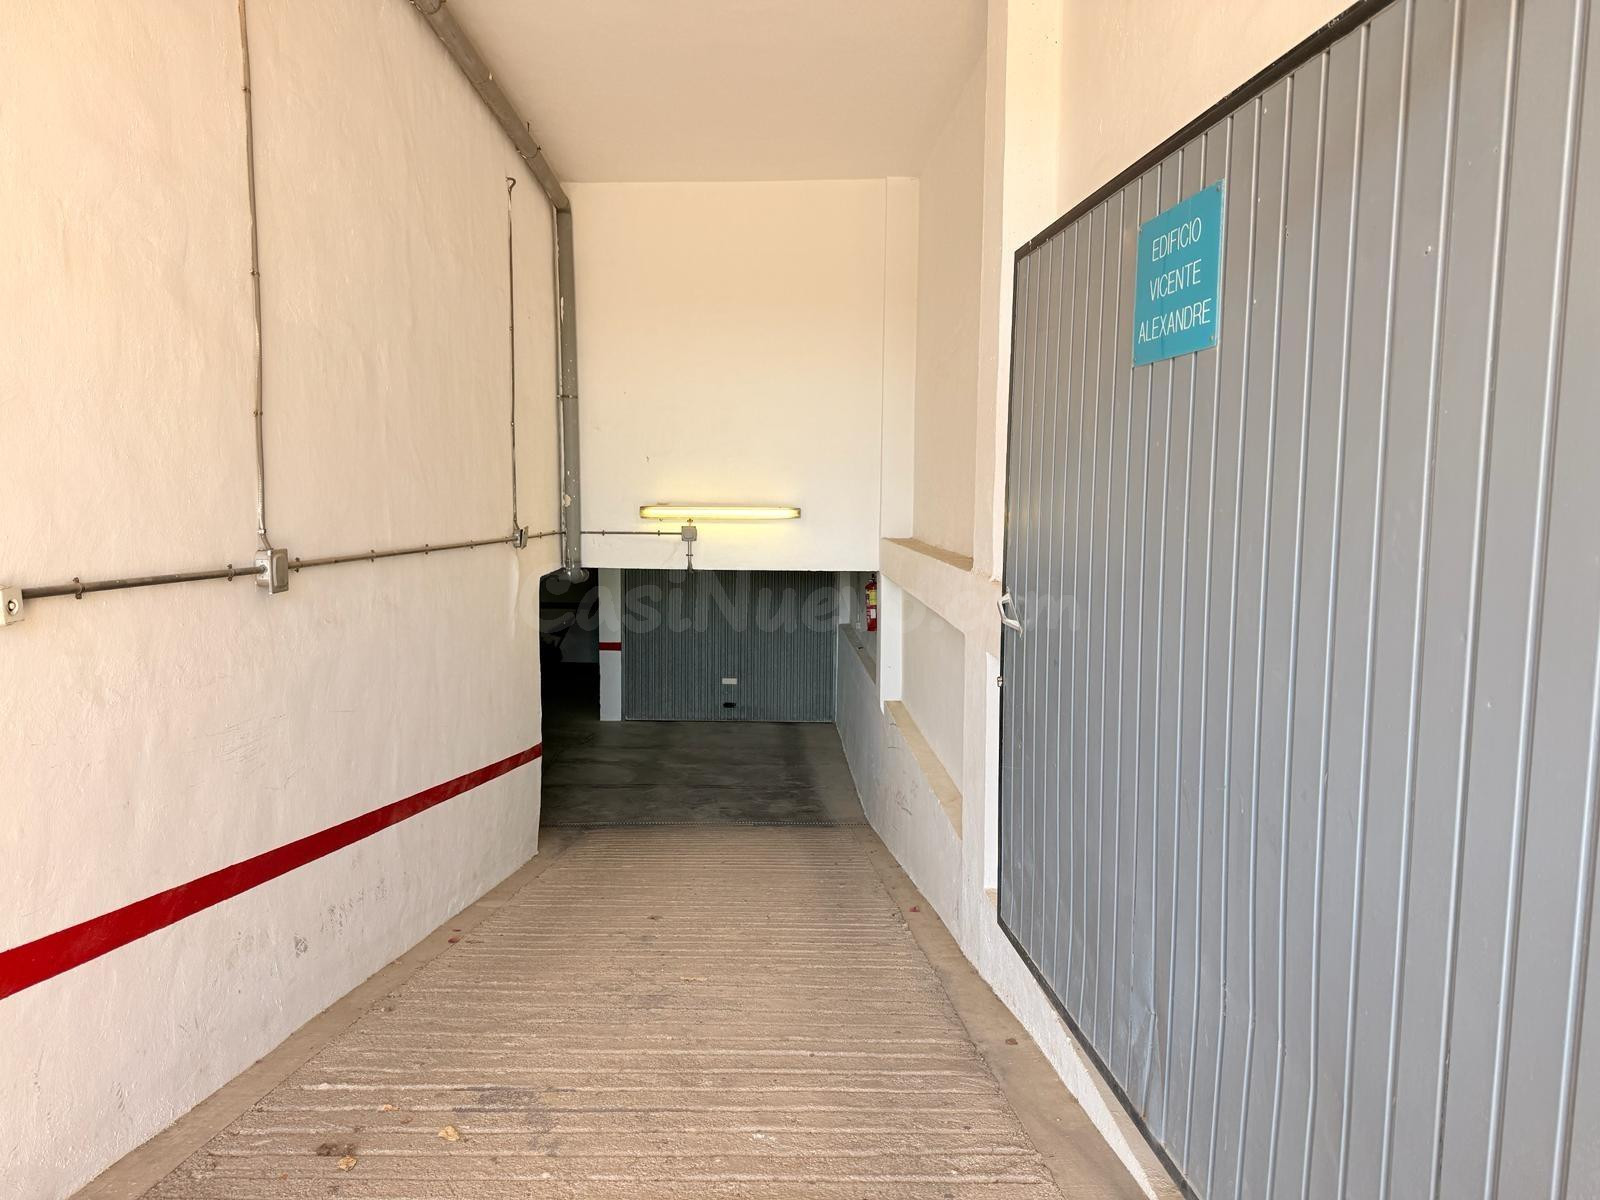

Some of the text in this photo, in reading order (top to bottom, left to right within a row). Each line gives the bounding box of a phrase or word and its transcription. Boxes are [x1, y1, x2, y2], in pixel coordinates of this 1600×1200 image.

[1152, 217, 1202, 262] EDIFICIO
[1150, 259, 1202, 301] VICENTE
[1138, 298, 1212, 344] ALEXANDRE
